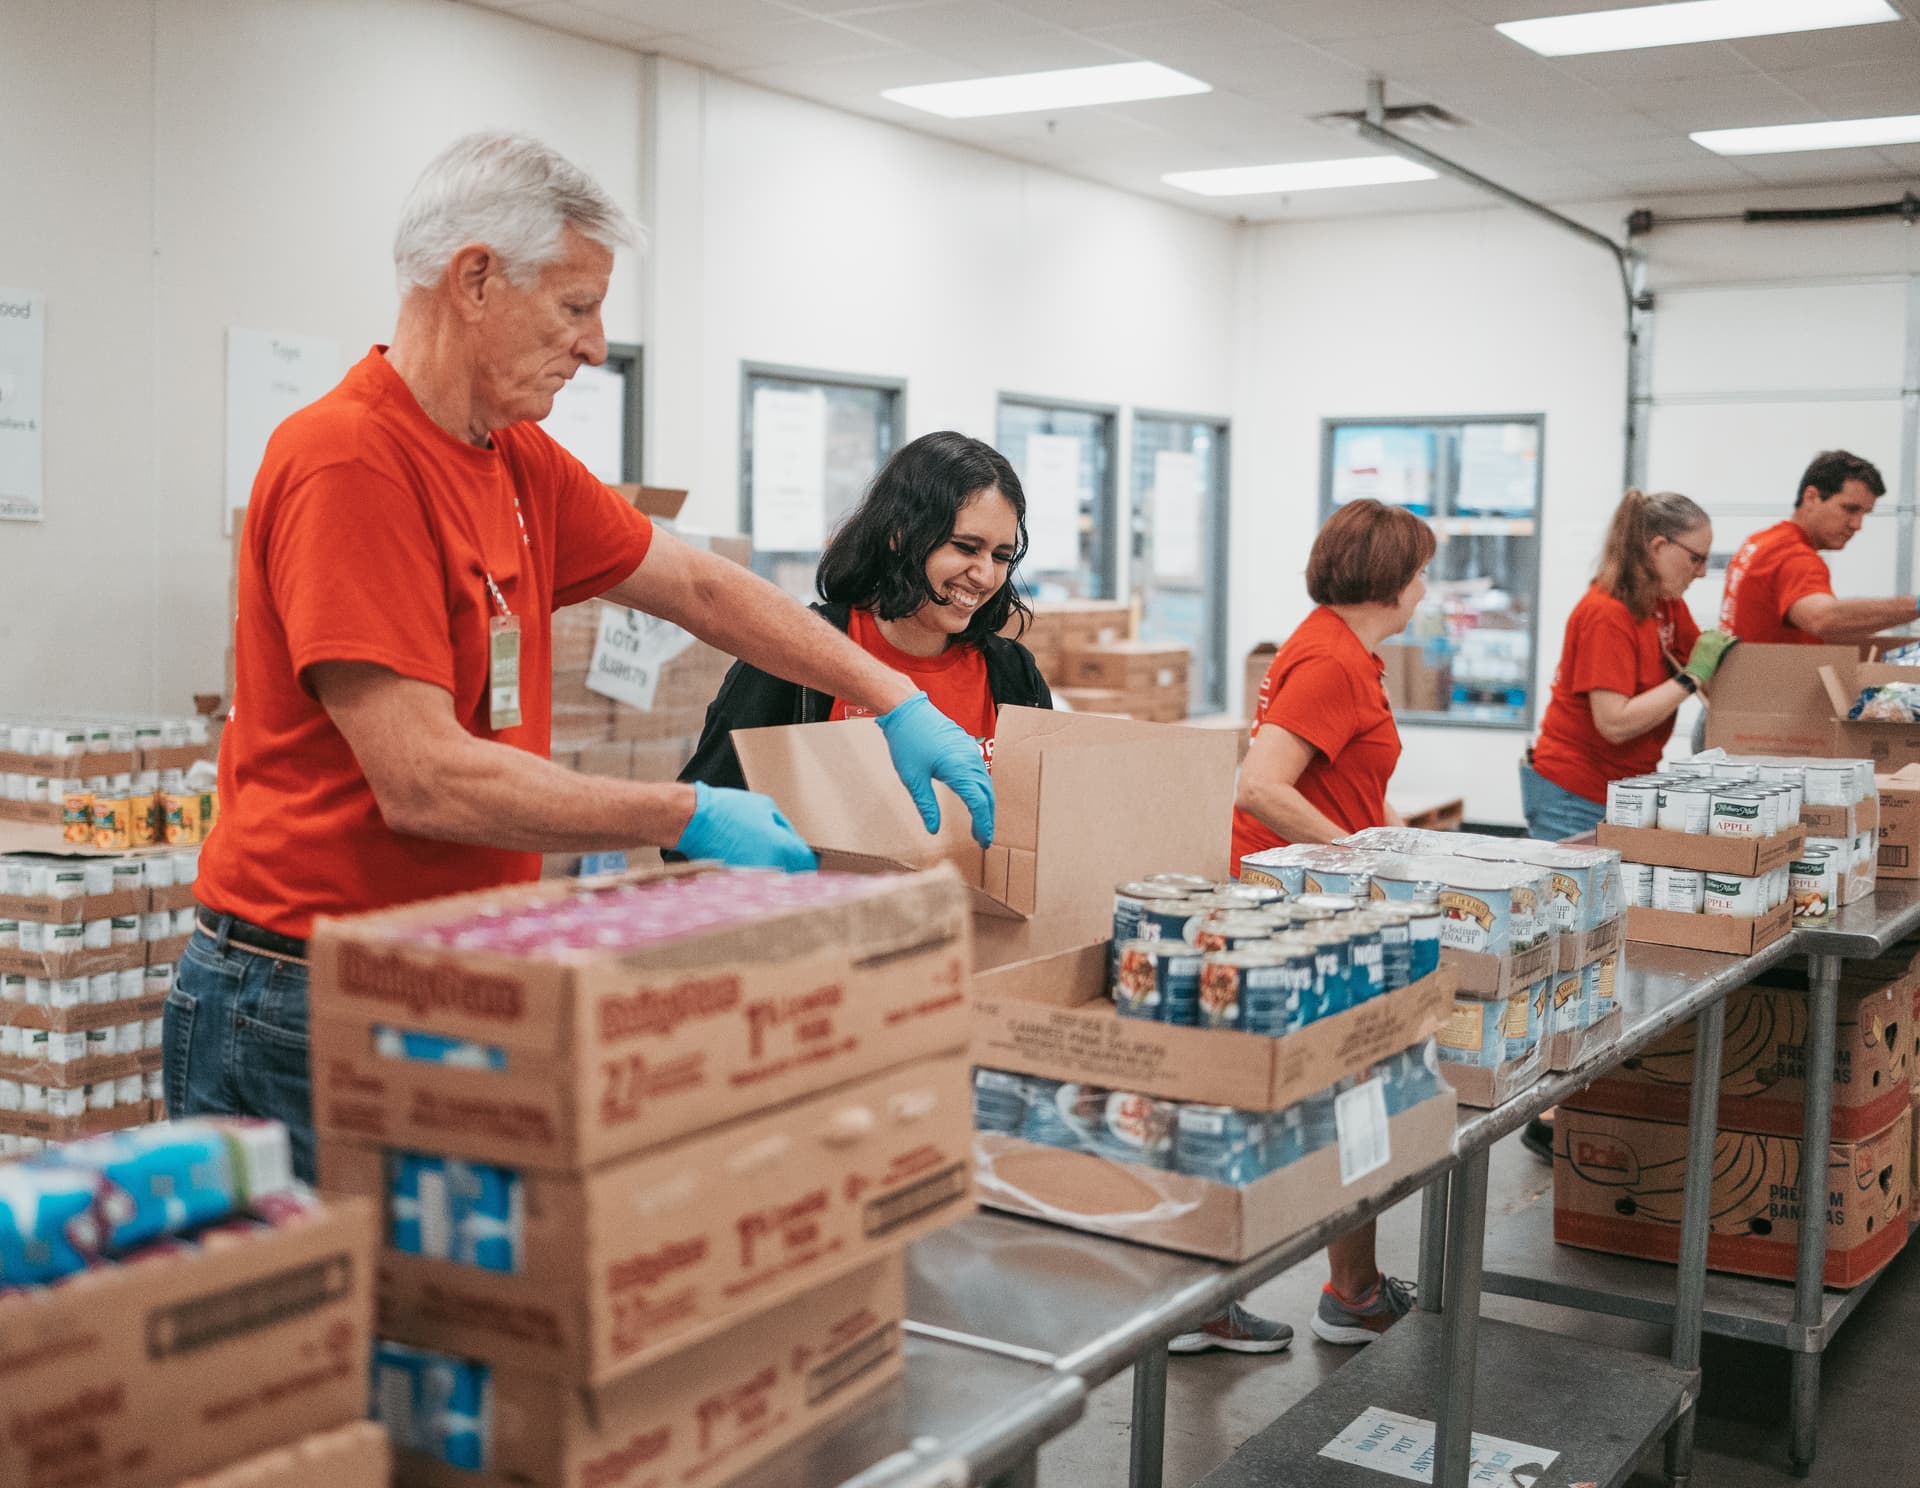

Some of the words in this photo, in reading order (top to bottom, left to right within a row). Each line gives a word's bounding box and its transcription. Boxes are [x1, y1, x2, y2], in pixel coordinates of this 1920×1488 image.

[0, 297, 31, 319] ood
[1717, 821, 1753, 833] APPLE
[1440, 931, 1476, 945] PINACH
[1390, 1434, 1418, 1454] PUT
